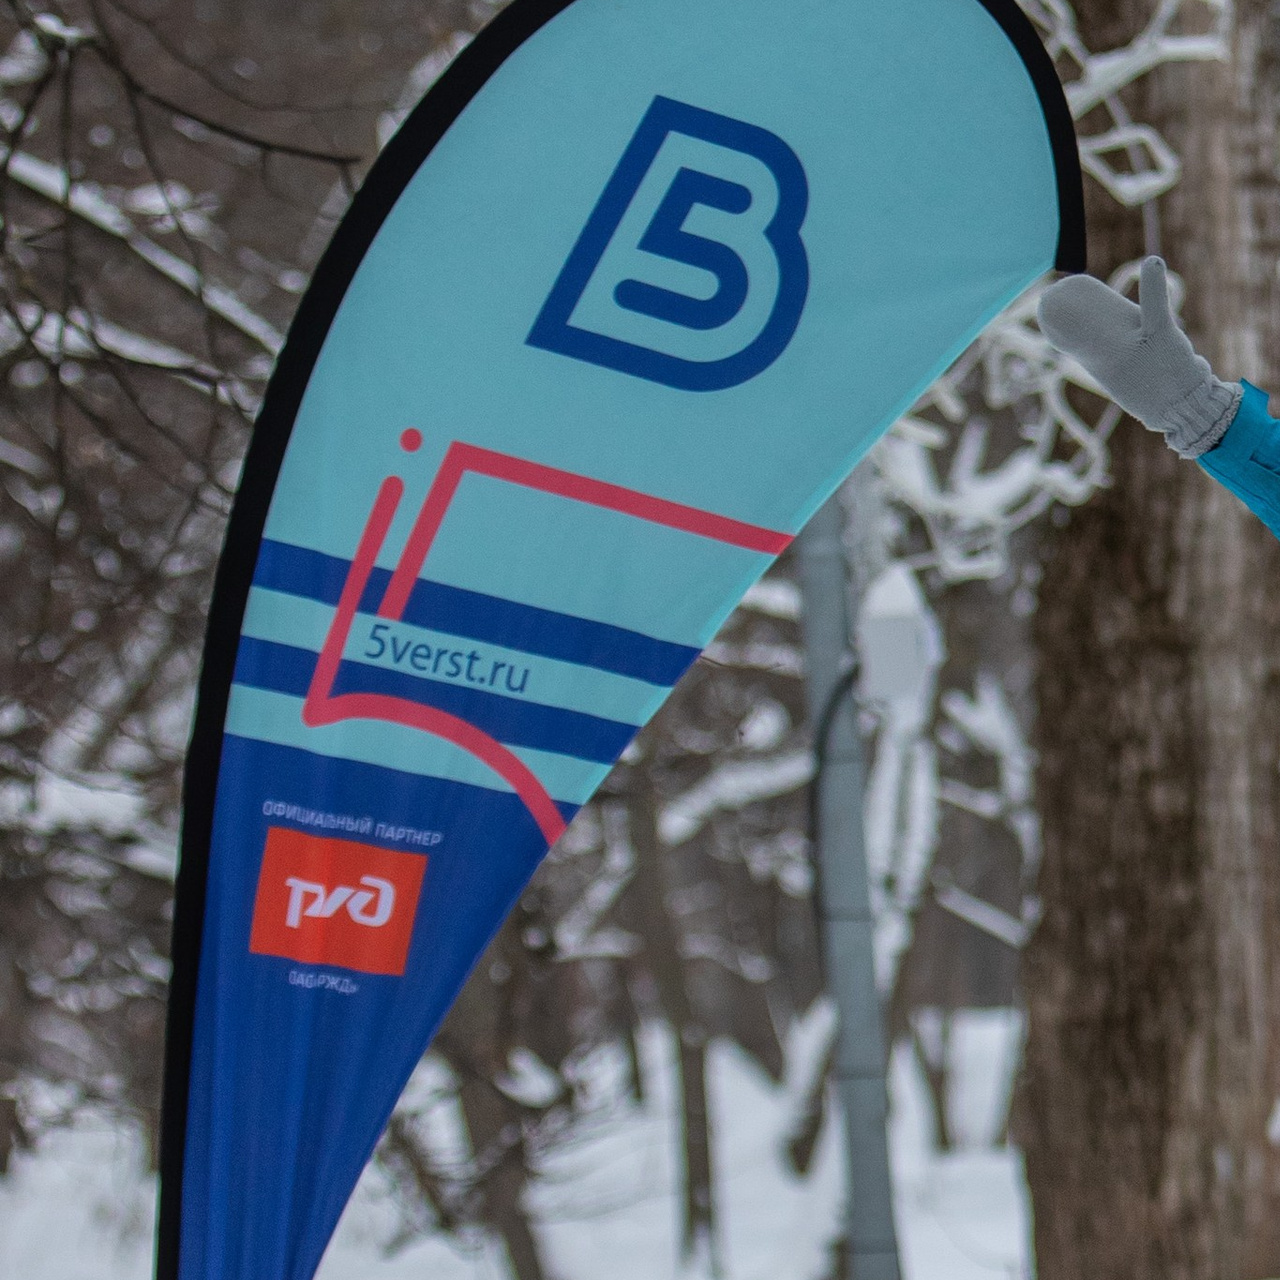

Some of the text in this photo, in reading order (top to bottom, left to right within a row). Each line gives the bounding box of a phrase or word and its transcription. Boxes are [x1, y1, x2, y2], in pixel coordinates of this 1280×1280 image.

[364, 624, 530, 694] 5verst.ru
[262, 799, 444, 847] ОФИЦИАЛЬНЫЙ ПАРТНЕР
